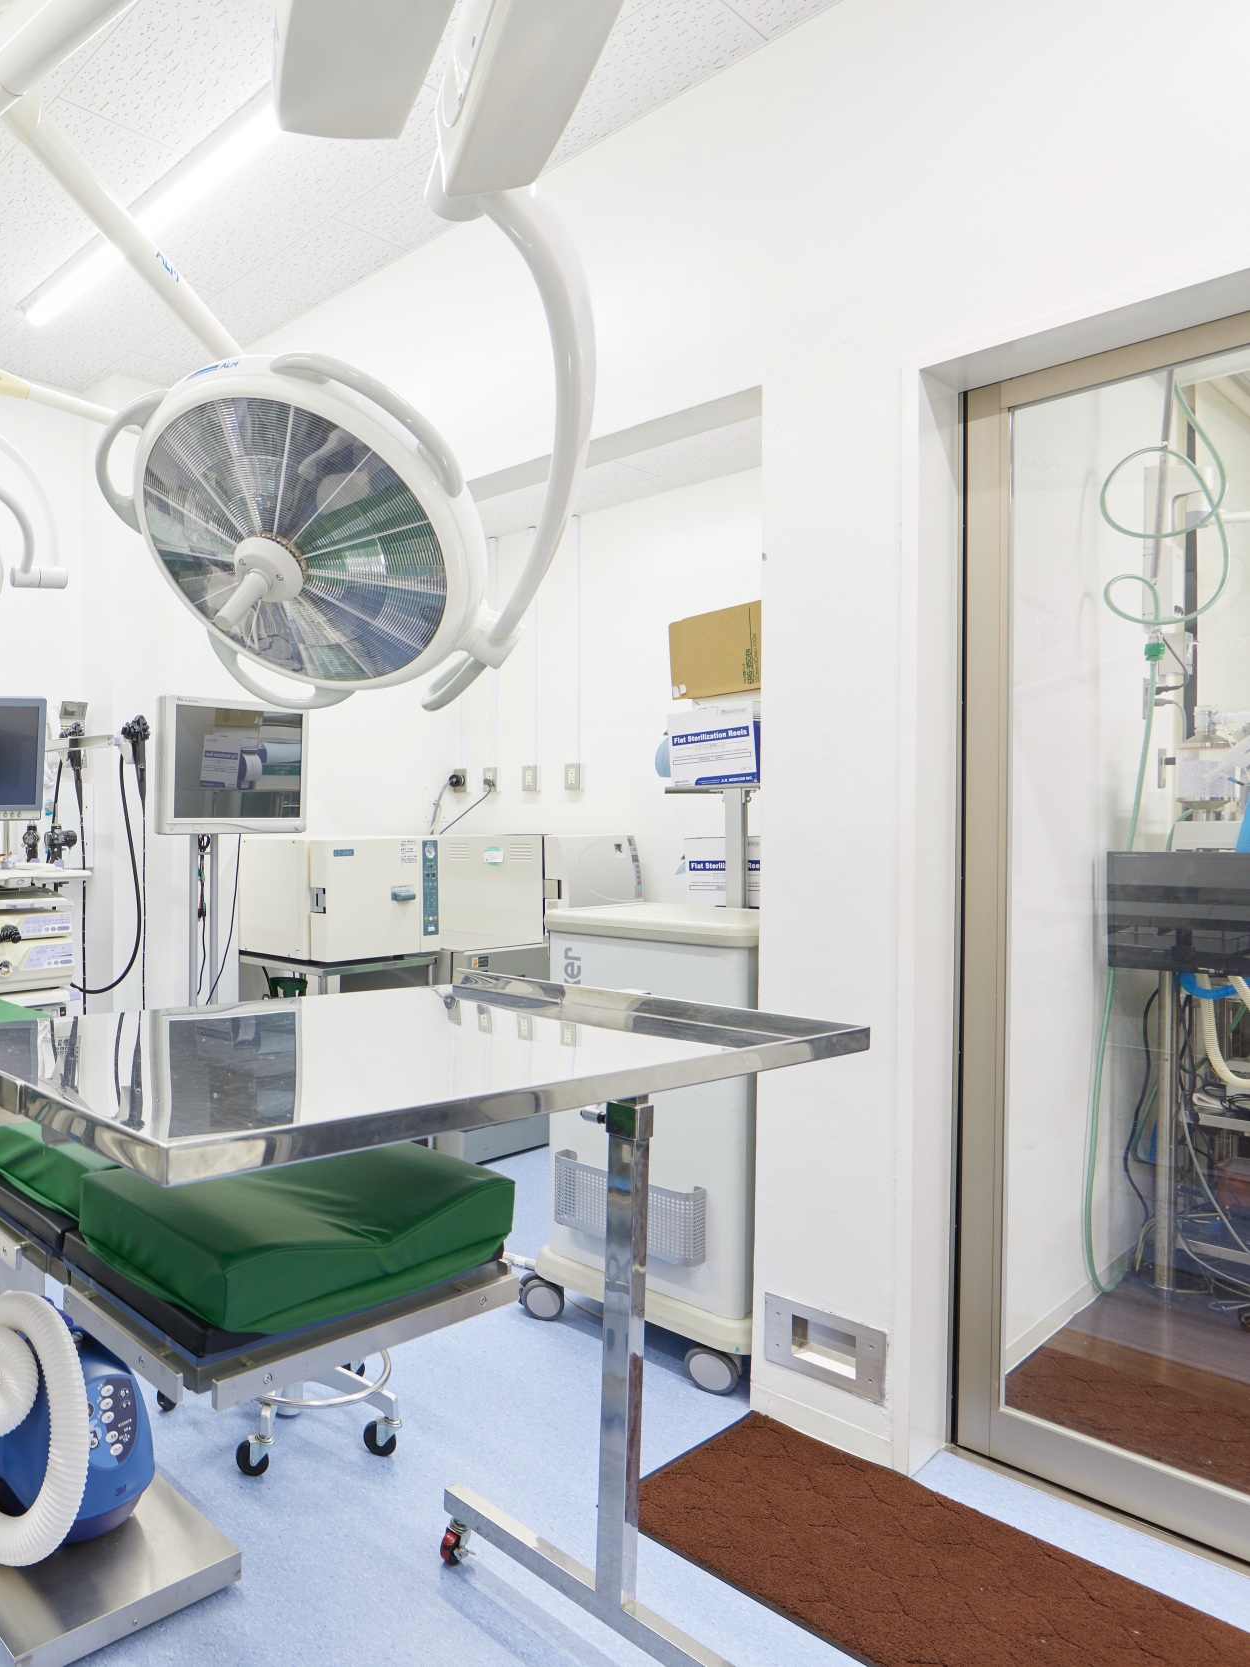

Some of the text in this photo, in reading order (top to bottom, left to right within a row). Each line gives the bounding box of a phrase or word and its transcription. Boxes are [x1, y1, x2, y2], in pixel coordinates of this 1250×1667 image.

[219, 360, 240, 370] ALM
[673, 728, 748, 745] Flat Sterilization Reels
[690, 862, 704, 870] Flat
[115, 1484, 127, 1497] 3M
